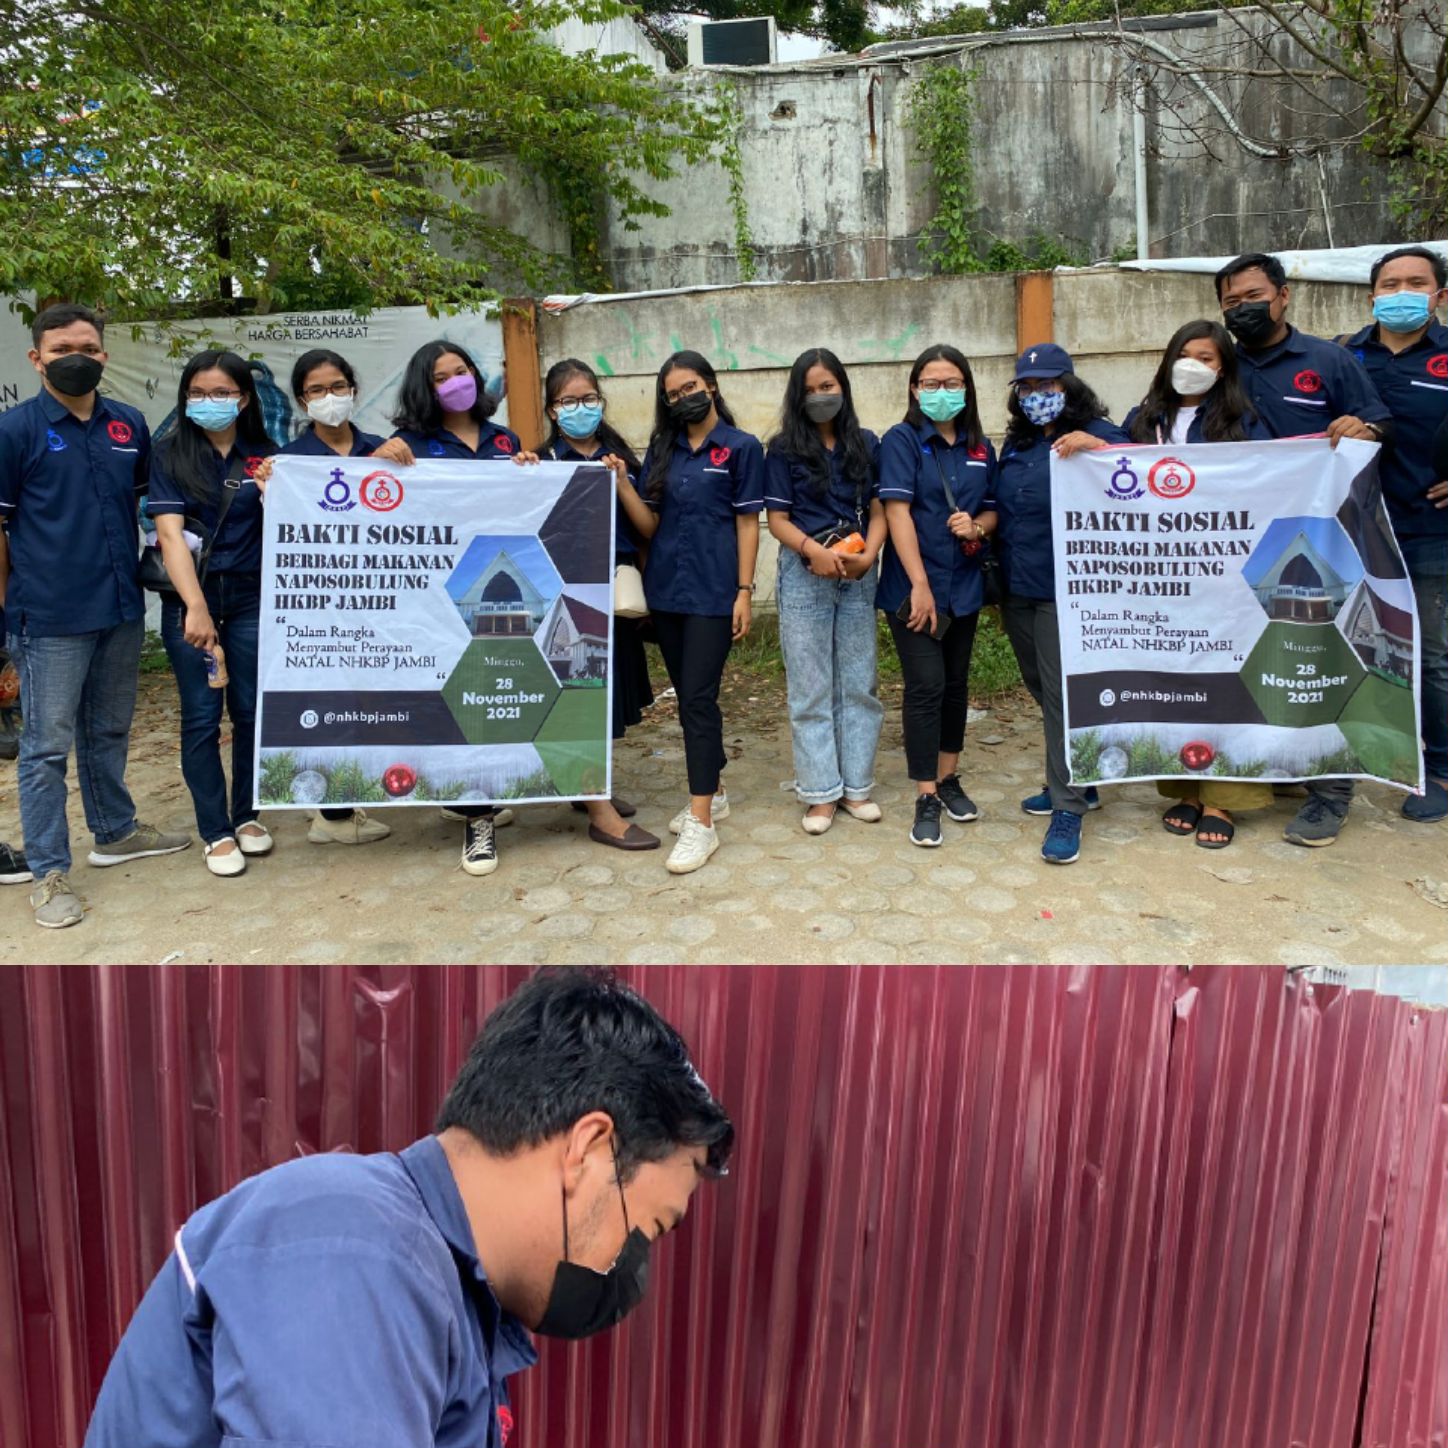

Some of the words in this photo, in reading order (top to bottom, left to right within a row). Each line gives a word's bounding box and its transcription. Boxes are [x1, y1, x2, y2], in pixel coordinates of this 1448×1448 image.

[284, 316, 320, 326] SERBA
[249, 330, 291, 341] HARGA
[295, 327, 368, 339] BERSAHABAT
[1064, 511, 1149, 532] BAKTI
[1158, 510, 1255, 533] SOSIAL
[277, 523, 360, 545] BAKTI
[366, 524, 458, 545] SOSIAL
[1066, 541, 1149, 556] BERBAGI
[1154, 540, 1251, 557] MAKANAN
[275, 553, 358, 570] BERBAGI
[362, 554, 454, 570] MAKANAN
[1067, 561, 1224, 576] NAPOSOBULUNG
[274, 574, 429, 589] NAPOSOBULUNG
[1068, 580, 1123, 595] HKBP
[1127, 581, 1191, 596] JAMBI
[274, 594, 331, 610] HKBP
[335, 595, 396, 610] JAMBI
[1081, 610, 1119, 622] Dalam
[1122, 611, 1169, 624] Rangka
[286, 626, 327, 638] Dalam
[330, 627, 375, 641] Rangka
[1082, 625, 1150, 640] Menyambut
[1156, 626, 1209, 641] Perayaan
[286, 642, 357, 657] Menyambut
[361, 642, 412, 656] Perayaan
[1082, 639, 1128, 651] NATAL
[1132, 639, 1186, 651] NHKBP
[1190, 639, 1232, 654] JAMBI
[285, 656, 335, 668] NATAL
[339, 656, 390, 668] NHKBP
[393, 656, 436, 671] JAMBI
[1296, 664, 1316, 675] 28
[496, 678, 513, 689] 28
[1262, 673, 1348, 689] November
[462, 690, 545, 705] November
[1120, 691, 1207, 704] @nhkbpjambi
[1288, 691, 1323, 703] 2021
[323, 711, 409, 725] @nhkbpjambi
[487, 707, 520, 719] 2021
